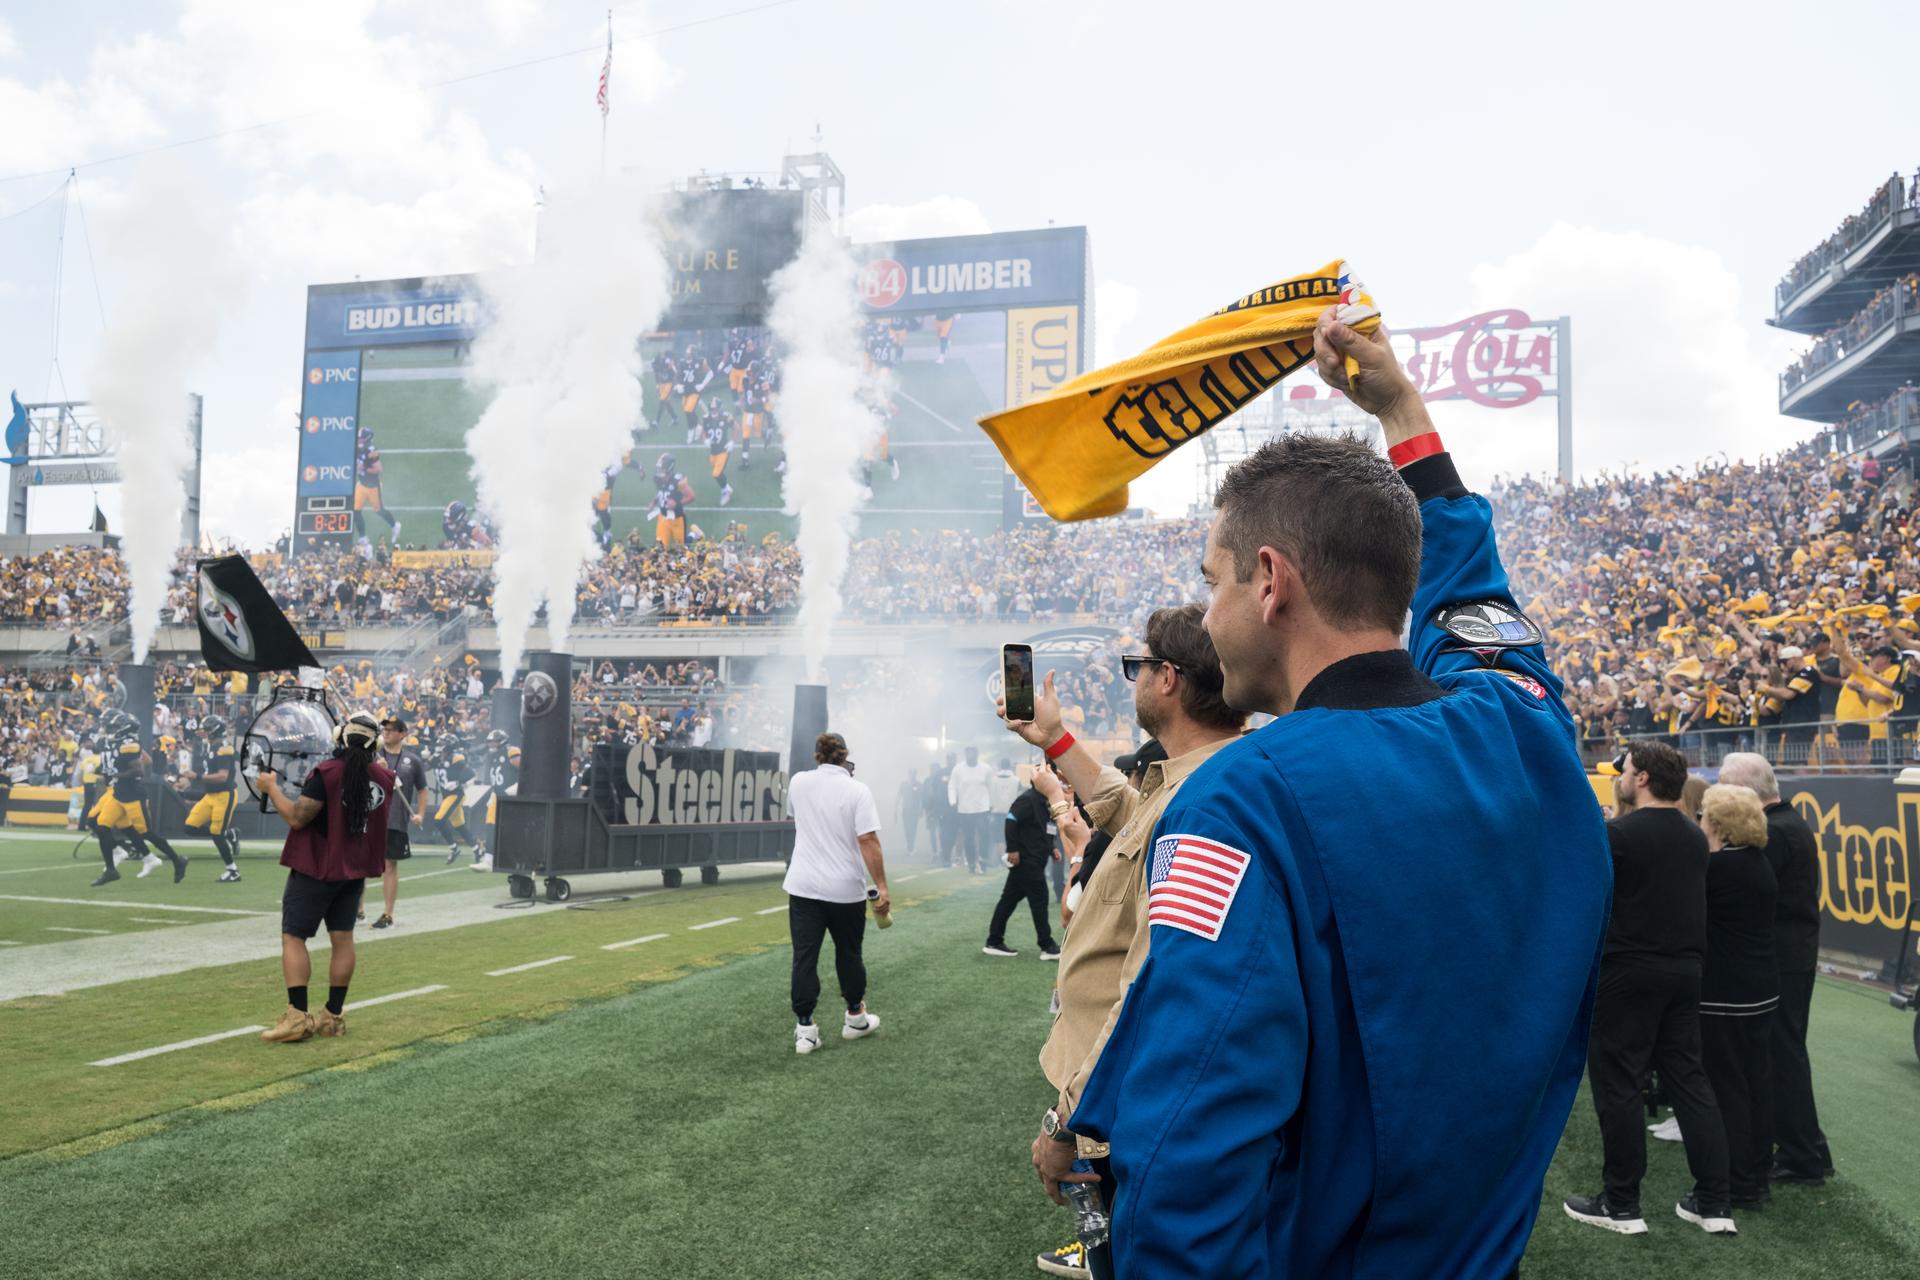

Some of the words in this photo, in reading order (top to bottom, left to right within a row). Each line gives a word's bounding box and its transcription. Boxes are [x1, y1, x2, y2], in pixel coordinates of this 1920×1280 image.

[911, 258, 1033, 296] LUMBER
[1238, 279, 1338, 310] ORIGINAL
[349, 307, 401, 330] BUD
[404, 301, 478, 327] LIGHT
[1015, 320, 1025, 345] LIFE
[1030, 313, 1069, 394] UP
[325, 367, 357, 383] PNC
[322, 416, 354, 431] PNC
[319, 465, 352, 480] PNC
[622, 729, 638, 746] 75
[624, 738, 790, 826] Steelers
